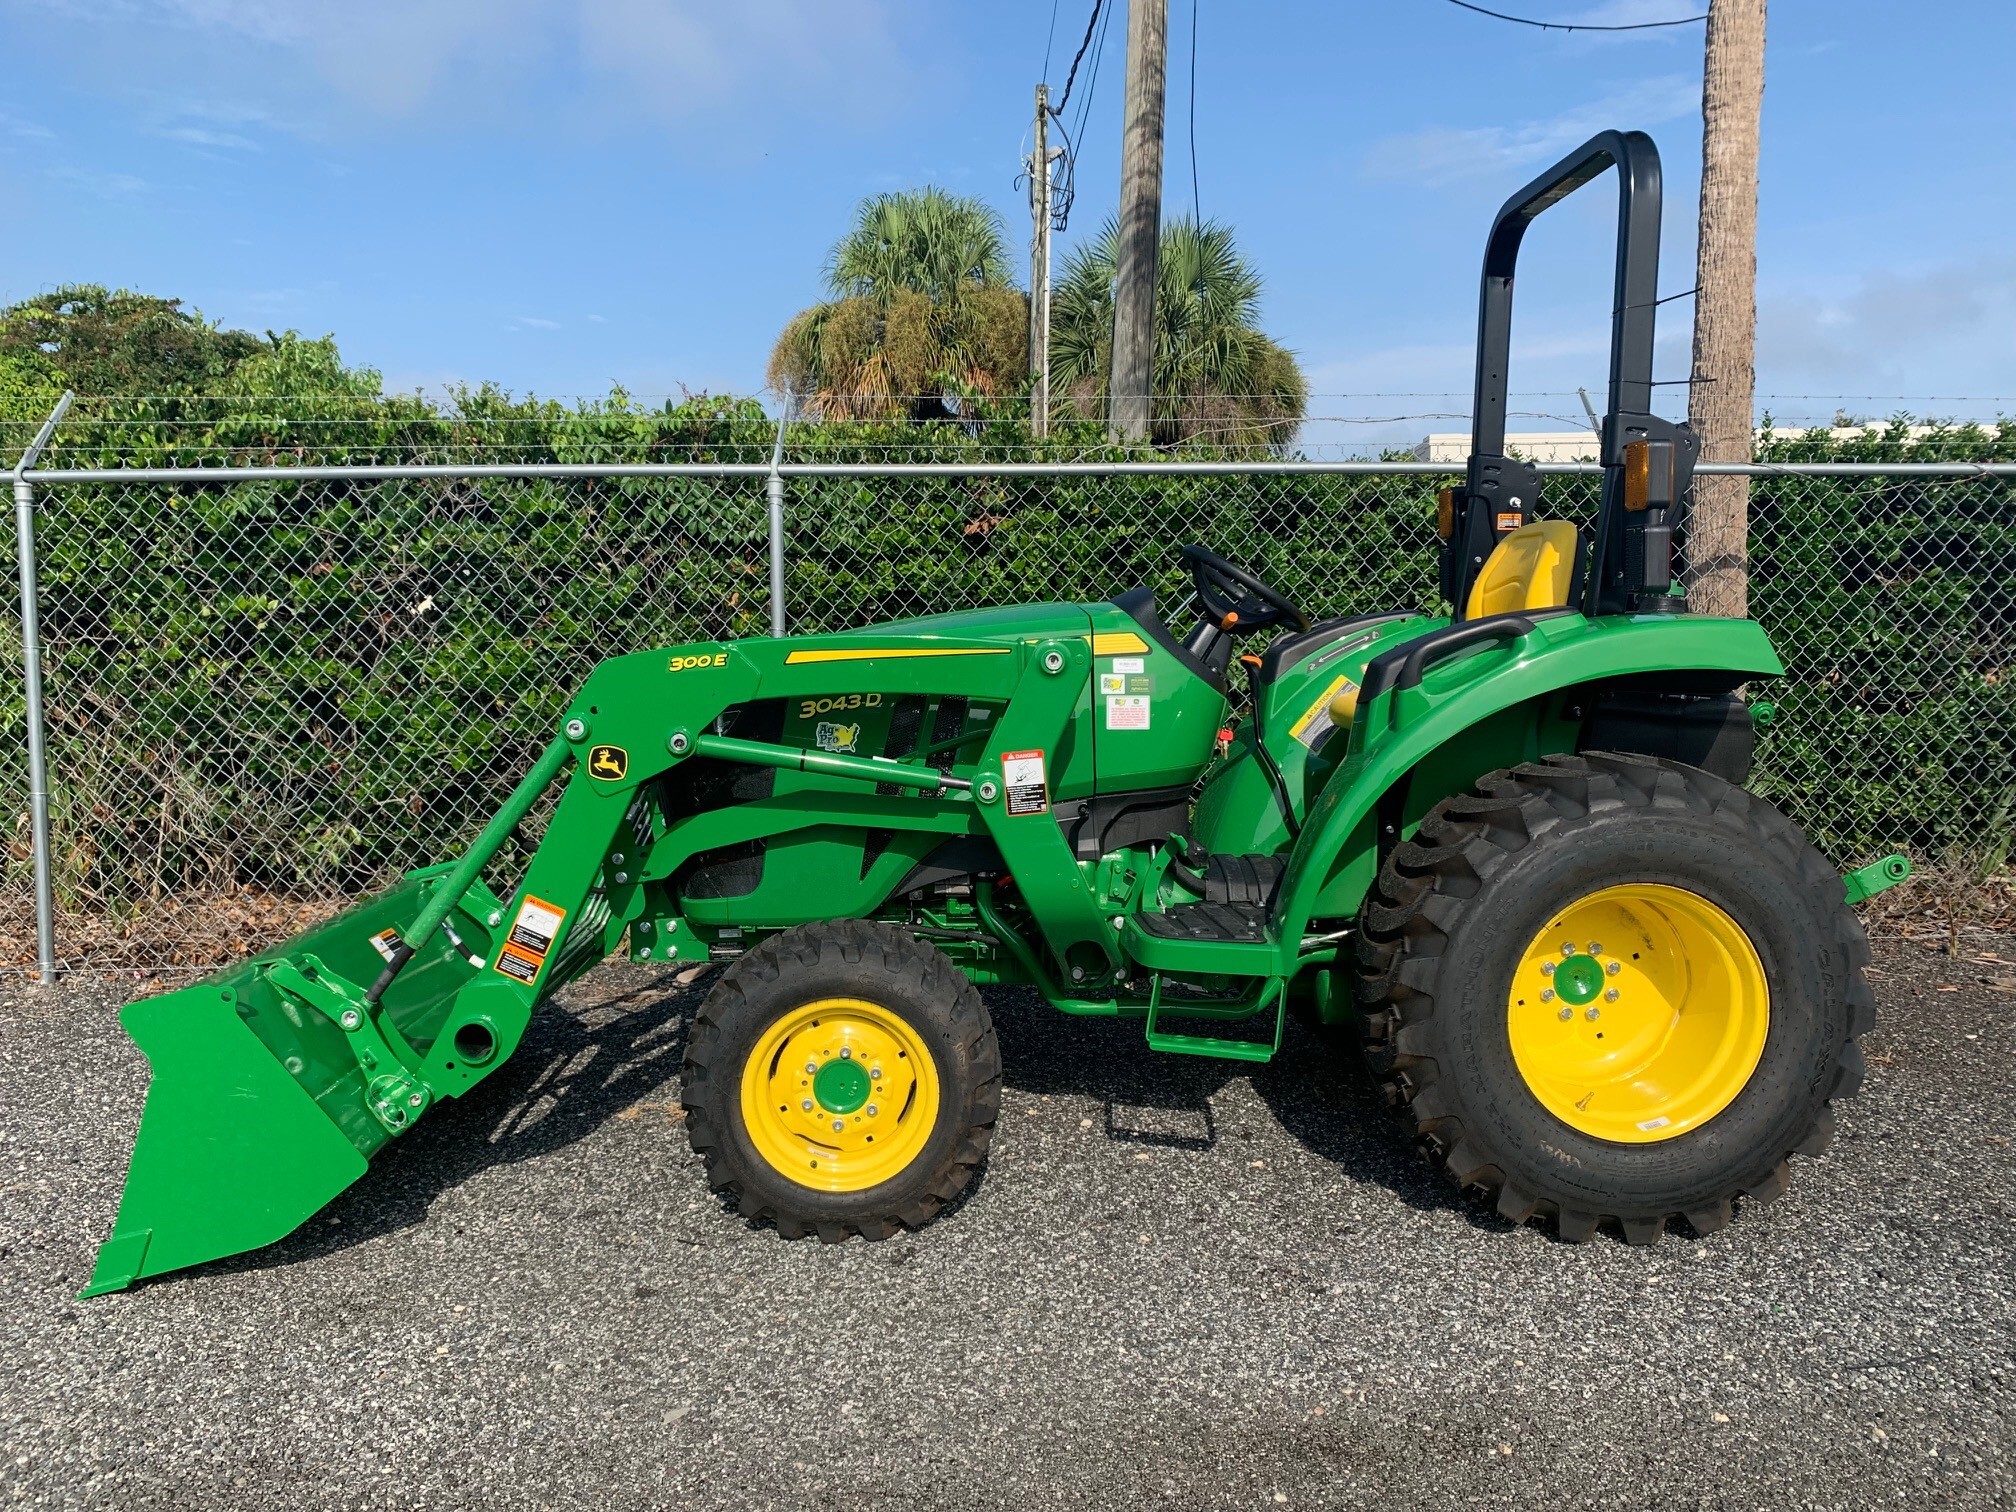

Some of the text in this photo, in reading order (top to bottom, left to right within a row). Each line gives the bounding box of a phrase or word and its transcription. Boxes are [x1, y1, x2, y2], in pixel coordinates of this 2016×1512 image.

[1310, 691, 1332, 715] CAUTION
[820, 735, 839, 744] Pro
[536, 900, 561, 914] WARNING
[1808, 944, 1836, 1097] GALAXY
